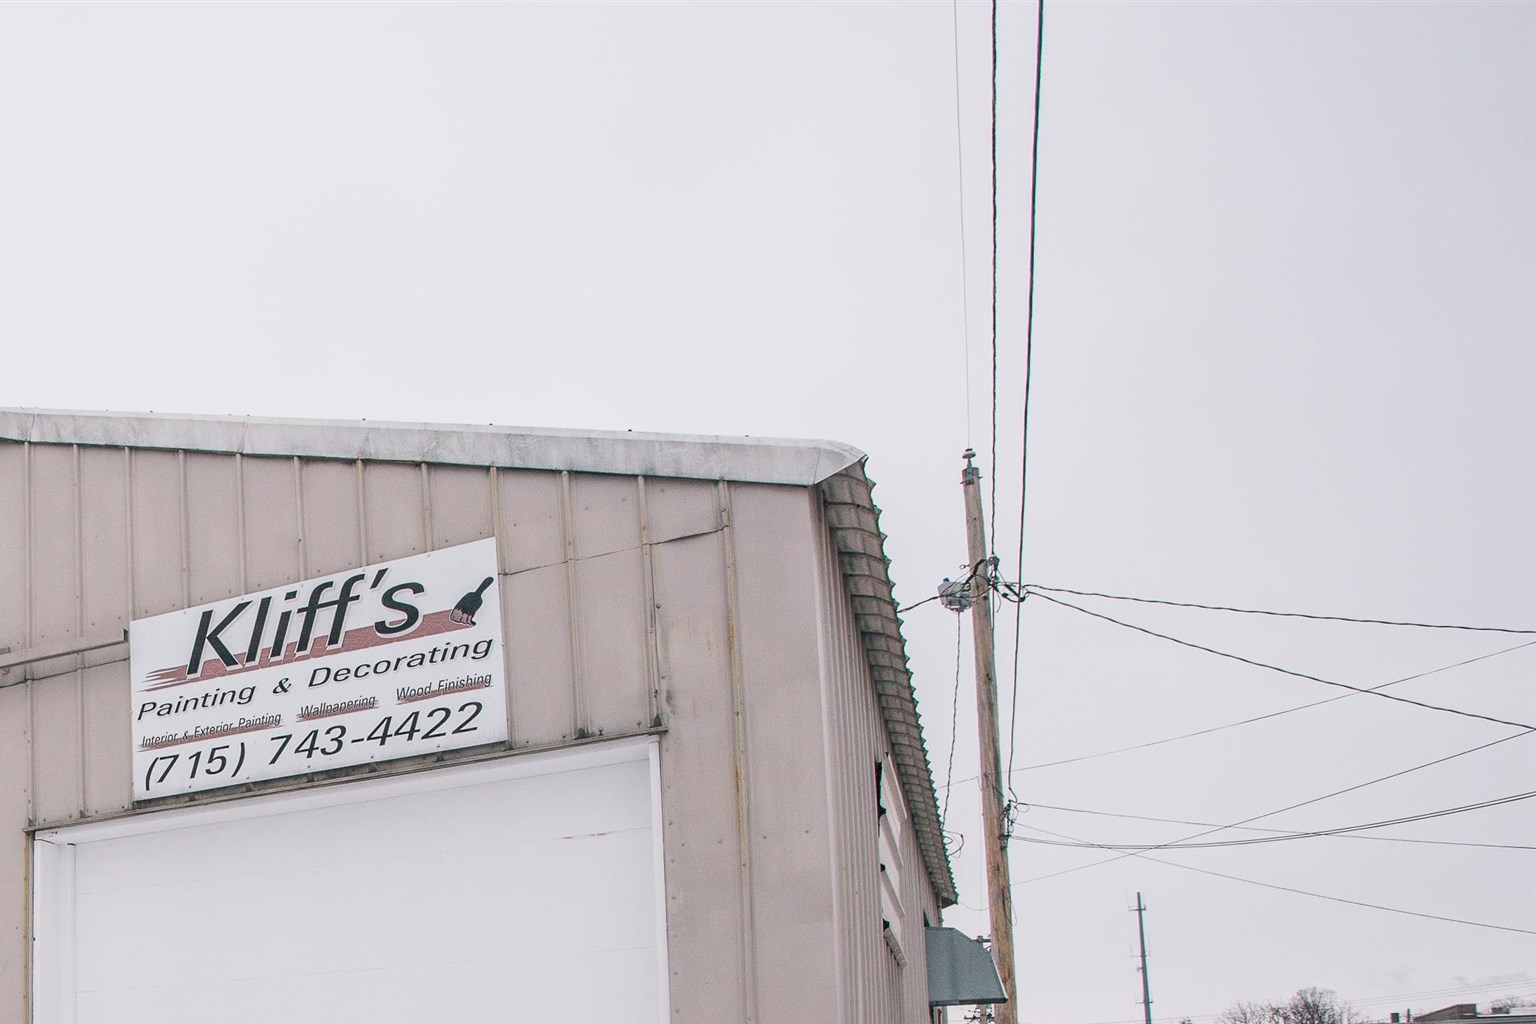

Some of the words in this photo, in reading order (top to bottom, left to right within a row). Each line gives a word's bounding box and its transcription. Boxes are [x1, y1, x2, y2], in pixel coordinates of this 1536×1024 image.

[187, 567, 425, 676] Kliff's
[137, 685, 256, 720] Painting
[272, 677, 292, 694] &
[308, 638, 494, 688] Decorating
[300, 694, 376, 718] Wallpapering
[396, 682, 432, 701] Wood
[437, 672, 492, 694] Finishing
[141, 731, 178, 748] Interior
[182, 730, 190, 741] &
[194, 721, 233, 737] Exterior
[238, 713, 282, 733] Painting
[145, 742, 246, 791] (715)
[268, 701, 483, 766] 743-4422
